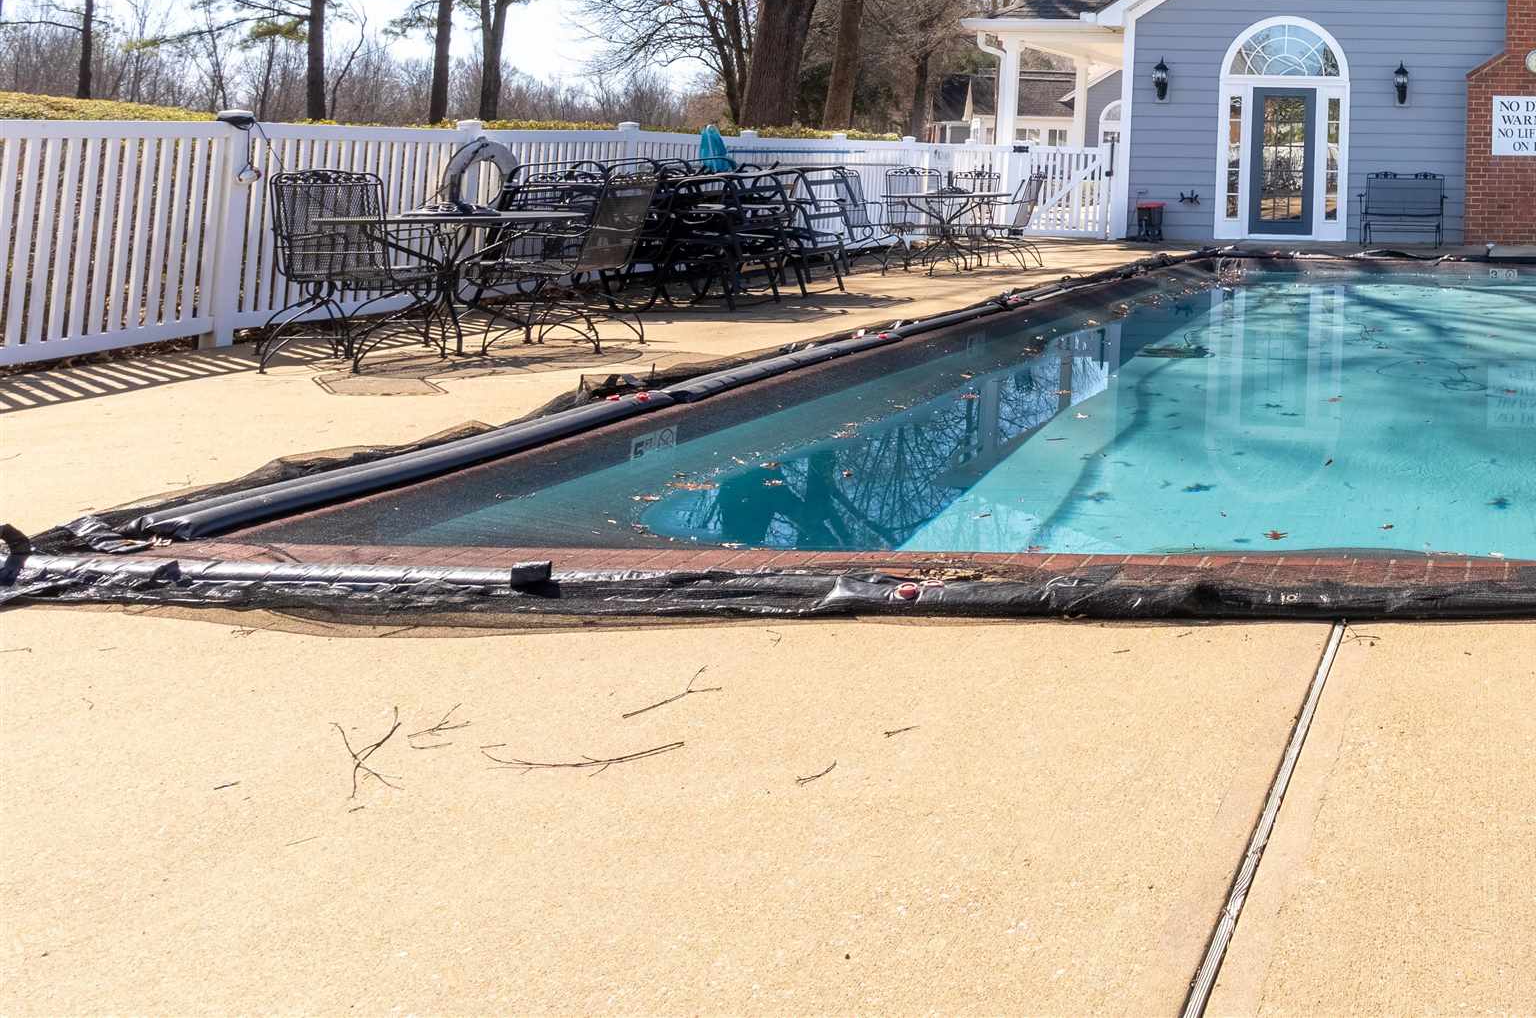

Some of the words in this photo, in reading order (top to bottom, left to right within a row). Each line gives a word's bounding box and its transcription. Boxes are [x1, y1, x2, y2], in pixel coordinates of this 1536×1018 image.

[1499, 100, 1520, 112] NO
[1498, 128, 1514, 139] NO
[1512, 141, 1529, 152] ON
